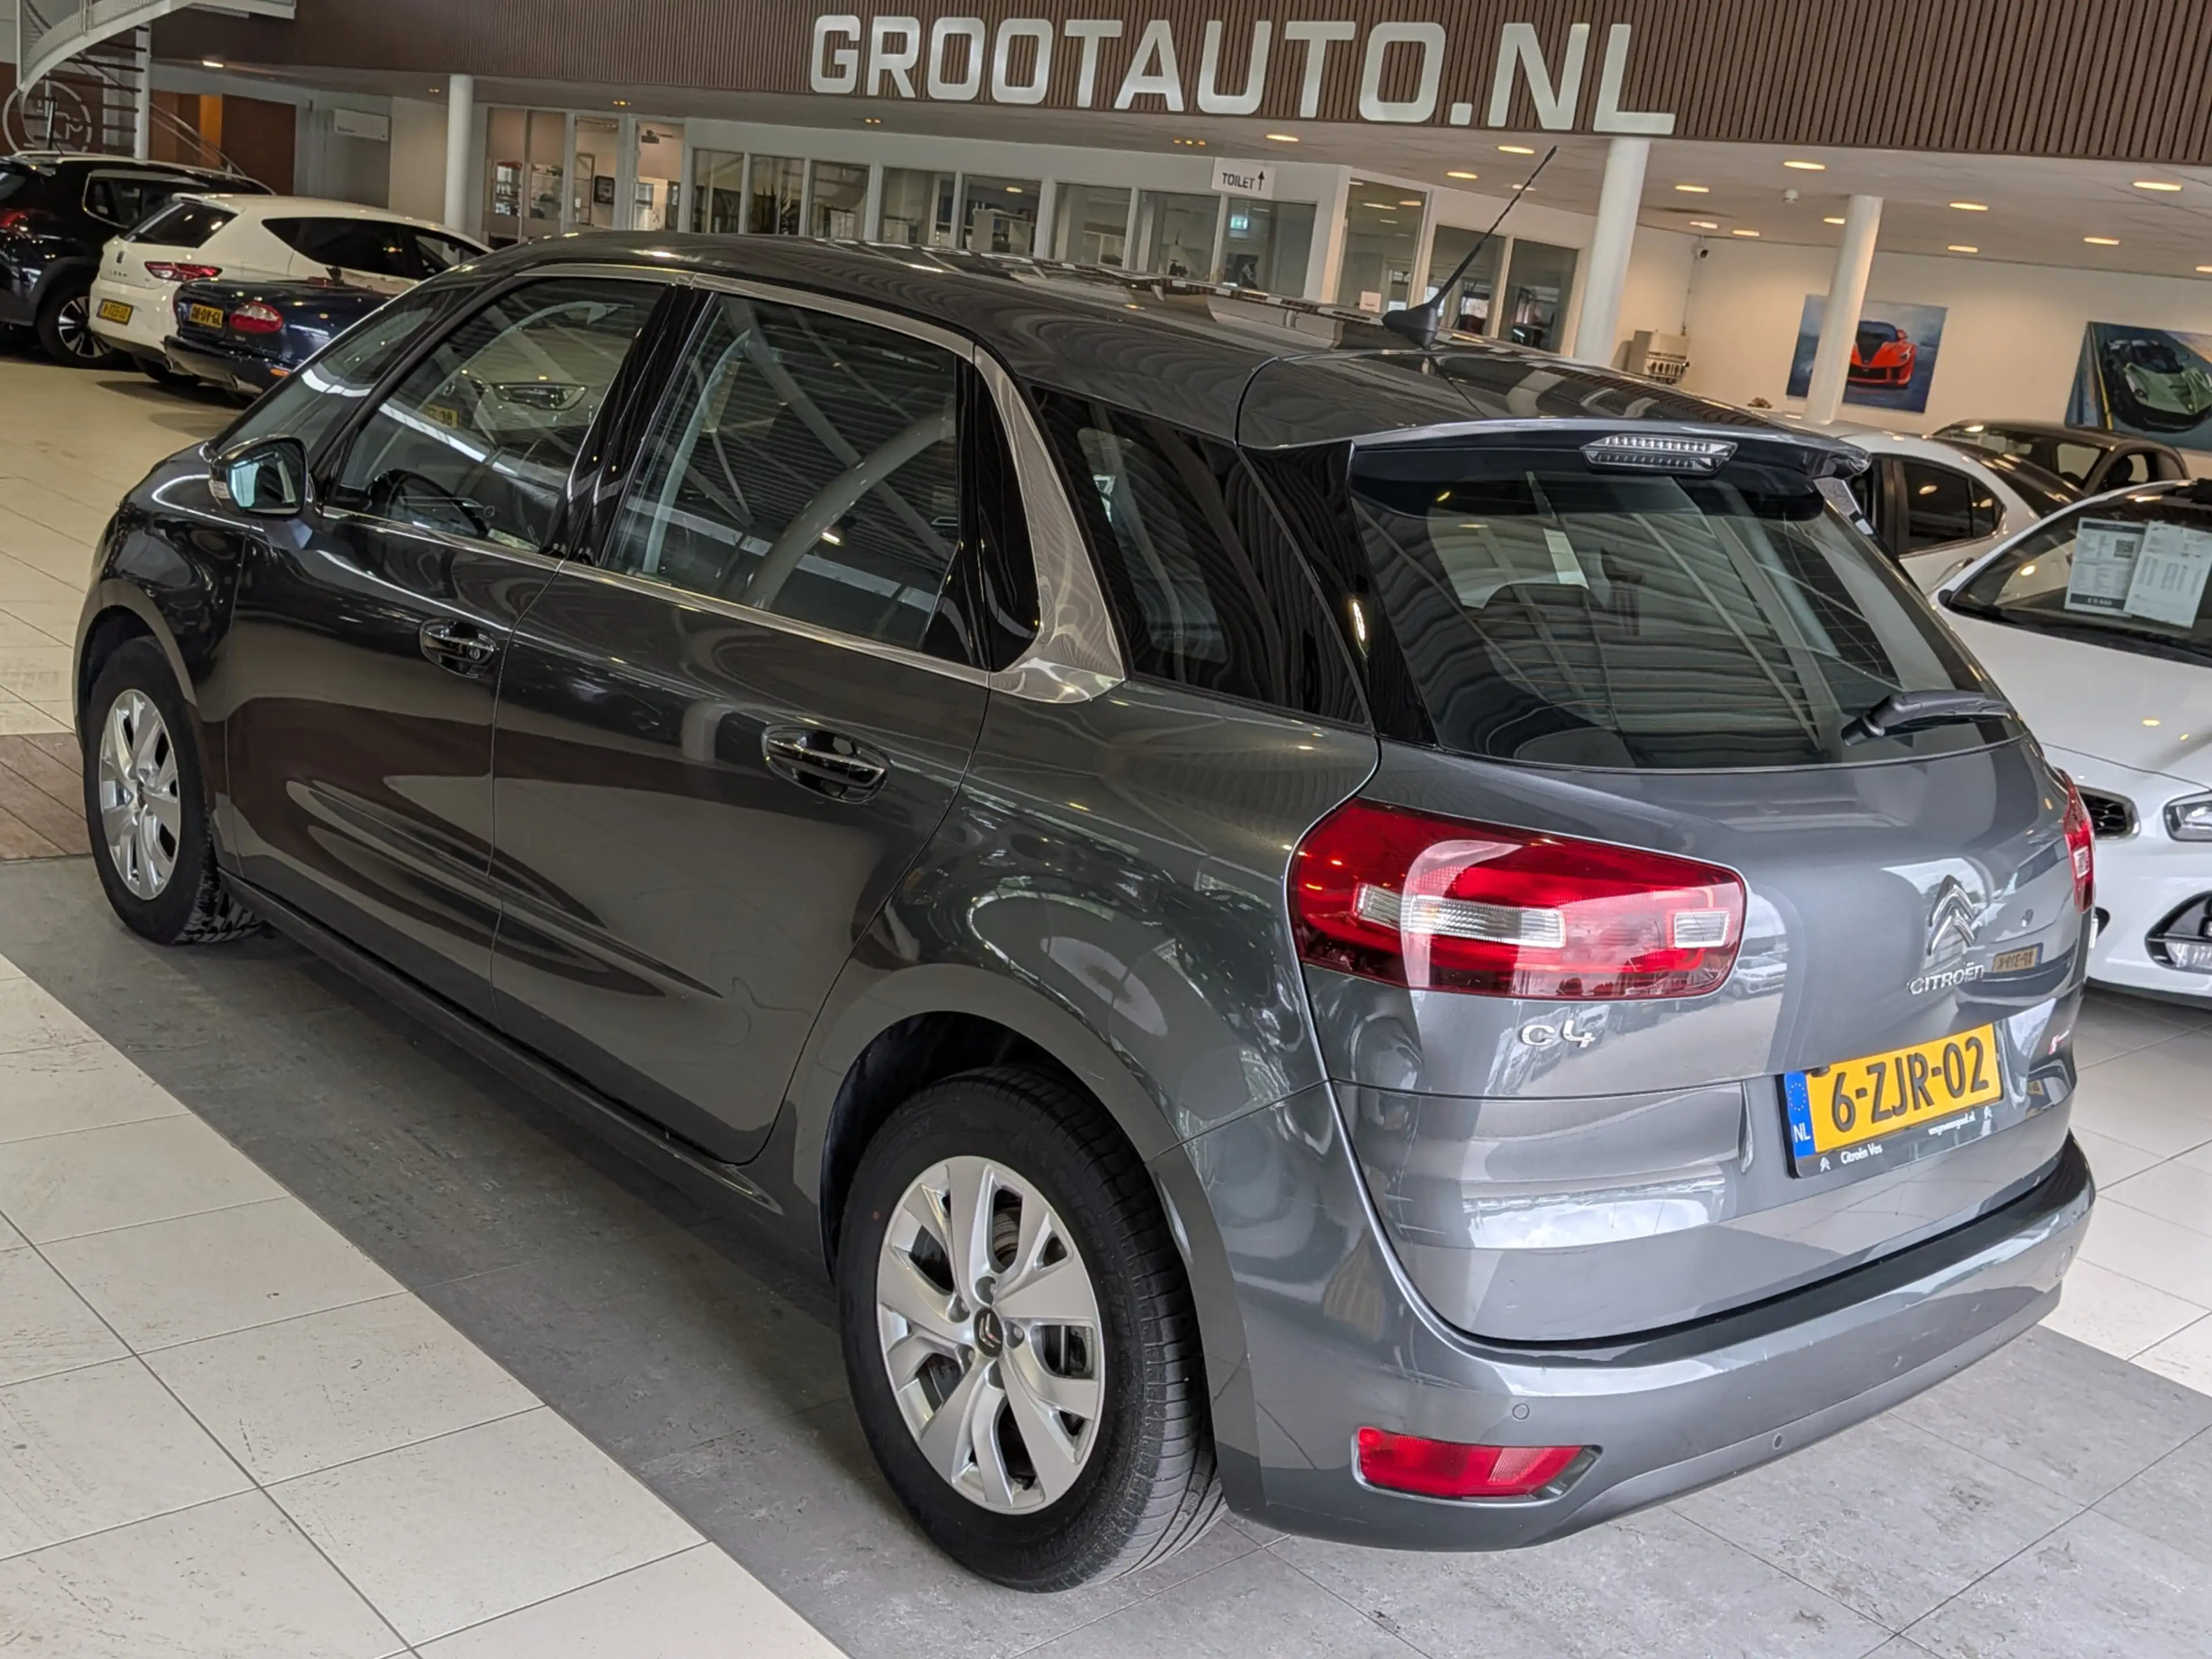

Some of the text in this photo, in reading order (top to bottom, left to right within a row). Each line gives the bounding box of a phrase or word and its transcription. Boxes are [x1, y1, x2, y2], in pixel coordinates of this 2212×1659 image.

[809, 14, 1676, 134] GROOTAUTO.NL
[1222, 172, 1255, 190] TOILET
[1521, 1020, 1596, 1048] C4
[1832, 1036, 1989, 1133] 6-ZJR-02
[1793, 1122, 1811, 1143] NL
[1840, 1142, 1883, 1164] Citroën Vos
